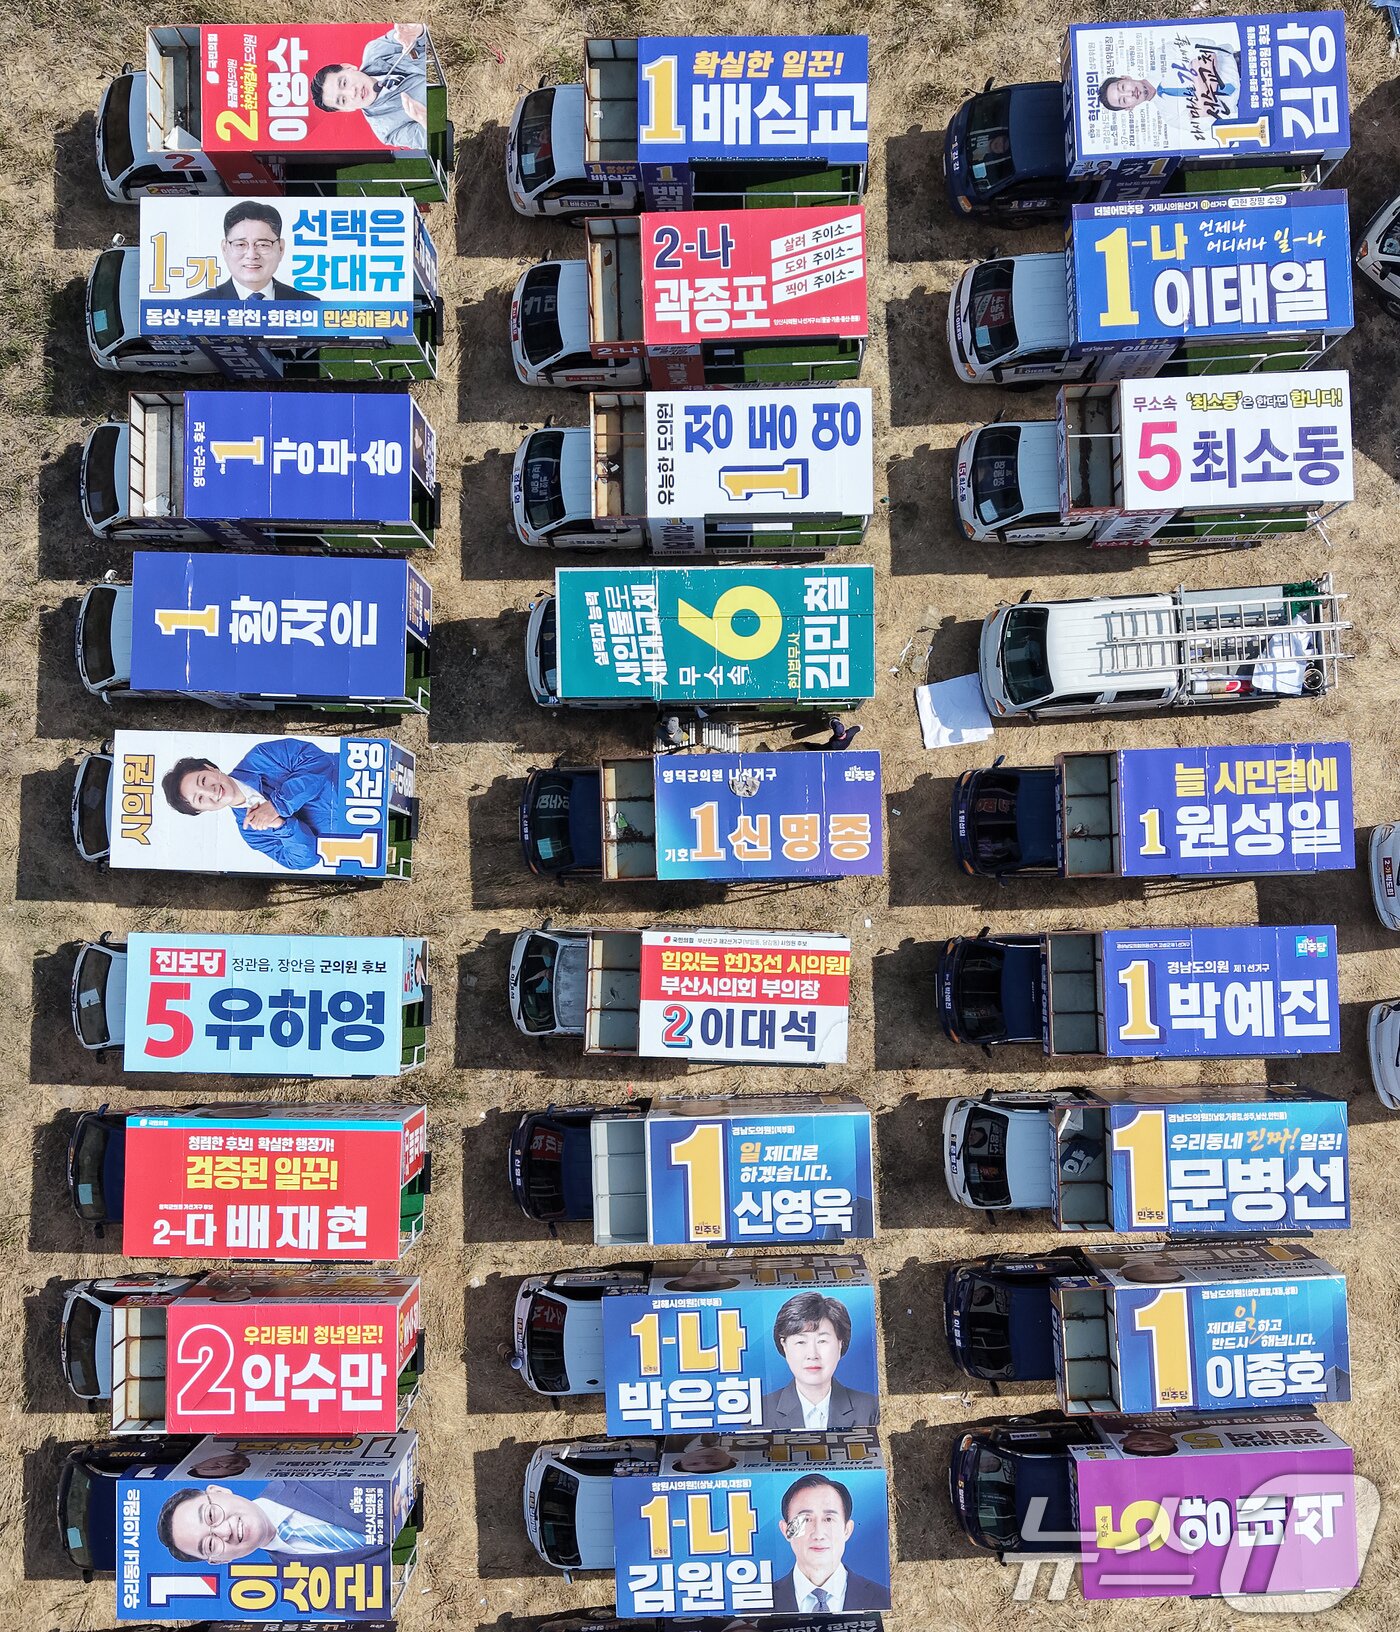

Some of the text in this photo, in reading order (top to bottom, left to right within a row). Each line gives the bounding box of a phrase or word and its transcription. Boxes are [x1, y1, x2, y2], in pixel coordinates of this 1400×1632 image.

[207, 34, 218, 69] 국민의힘
[692, 50, 844, 78] 확실한 일꾼!
[1258, 24, 1274, 108] 경상남도의원 후보
[268, 38, 308, 141] 이영수
[1277, 22, 1339, 140] 김강
[640, 54, 868, 145] 1 배심교
[216, 110, 258, 141] 2
[1210, 116, 1270, 148] 1
[165, 154, 202, 170] 2
[656, 166, 678, 181] 1
[1140, 158, 1170, 178] 1
[1094, 204, 1144, 216] 더불어민주당
[1231, 198, 1248, 208] 고현
[292, 208, 406, 246] 선택은
[784, 235, 806, 252] 살려
[1200, 220, 1246, 237] 언제나
[149, 231, 222, 293] 1-가
[292, 253, 406, 292] 강대규
[653, 223, 735, 270] 2-나
[785, 257, 808, 274] 도와
[1095, 222, 1268, 327] 1-나 어디서나
[654, 275, 771, 333] 곽종포
[785, 281, 809, 296] 찍어
[1154, 260, 1328, 328] 이태열
[146, 308, 408, 328] 동상·부원·활천·회현의 민생해결사
[1133, 388, 1342, 412] 무소속 한다면 합니다!
[684, 402, 862, 454] 정동영
[193, 421, 206, 488] 영덕군수 후보
[210, 436, 265, 466] 1
[273, 437, 402, 476] 강부송
[656, 402, 675, 506] 유능한 도의원
[1137, 421, 1182, 491] 5
[1190, 424, 1344, 488] 최소동
[719, 458, 810, 500] 1
[154, 604, 220, 637] 1
[229, 595, 378, 648] 황재은
[584, 592, 610, 666] 실력과 능력
[604, 584, 642, 686] 새인물로
[630, 583, 669, 686] 세대교체
[677, 585, 782, 660] 6
[802, 576, 850, 690] 김민철
[679, 664, 750, 687] 무소속
[344, 741, 384, 826] 이순영
[662, 768, 724, 784] 영덕군의원
[844, 769, 876, 782] 민주당
[1174, 757, 1338, 798] 늘 시민곁에
[120, 754, 155, 846] 시의원
[664, 801, 872, 863] 기호 1 신명종
[1138, 800, 1342, 858] 1 원성일
[316, 828, 382, 868] 1
[155, 950, 222, 974] 진보당
[661, 950, 851, 976] 힘있는 현)3선 시의원!
[1298, 942, 1326, 953] 민주당
[232, 958, 386, 974] 정관읍, 장안읍 군의원 후보
[1166, 960, 1270, 975] 경남도의원 제1선거구
[660, 975, 820, 1000] 부산시의회 부의장
[1118, 960, 1331, 1042] 1 박예진
[144, 982, 386, 1058] 5 유하영
[662, 1004, 818, 1052] 2 이대석
[732, 1126, 770, 1136] 경남도의원
[1168, 1114, 1208, 1122] 경남도의원
[188, 1136, 334, 1152] 청렴한 후보! 확실한 행정가!
[740, 1142, 818, 1164] 일 제대로
[1170, 1127, 1342, 1153] 우리동네 진짜! 일꾼!
[186, 1156, 338, 1190] 검증된 일꾼!
[670, 1124, 724, 1242] 1
[740, 1166, 832, 1184] 하겠습니다.
[1113, 1108, 1347, 1226] 1 문병선
[153, 1204, 368, 1250] 2-다 배재현
[732, 1188, 854, 1235] 신영욱
[1136, 1210, 1164, 1221] 민주당
[694, 1224, 721, 1236] 민주당
[652, 1298, 694, 1309] 김해시의원
[1201, 1288, 1242, 1300] 경남도의원
[244, 1325, 384, 1346] 우리동네 청년일꾼!
[630, 1308, 748, 1376] 1-나
[1206, 1320, 1282, 1334] 제대로 하고
[1212, 1334, 1316, 1350] 반드시 해냅니다.
[1134, 1288, 1328, 1408] 1 이종호
[176, 1323, 388, 1416] 2 안수만
[618, 1377, 764, 1430] 박은희
[1160, 1389, 1188, 1400] 민주당
[1086, 1451, 1106, 1460] 5
[1181, 1428, 1324, 1450] 양태석 5
[1234, 1438, 1332, 1448] 거제시의원
[353, 1487, 362, 1514] 민주당
[652, 1480, 694, 1492] 창원시의원
[365, 1493, 376, 1545] 부산시의원
[640, 1490, 758, 1558] 1-나
[1094, 1500, 1171, 1552] 5
[1100, 1516, 1108, 1538] 무소속
[1178, 1492, 1344, 1550] 양태석
[123, 1489, 141, 1609] 우리동네 시의원은
[147, 1573, 220, 1608] 1
[228, 1562, 384, 1613] 이상곤
[628, 1560, 774, 1614] 김원일
